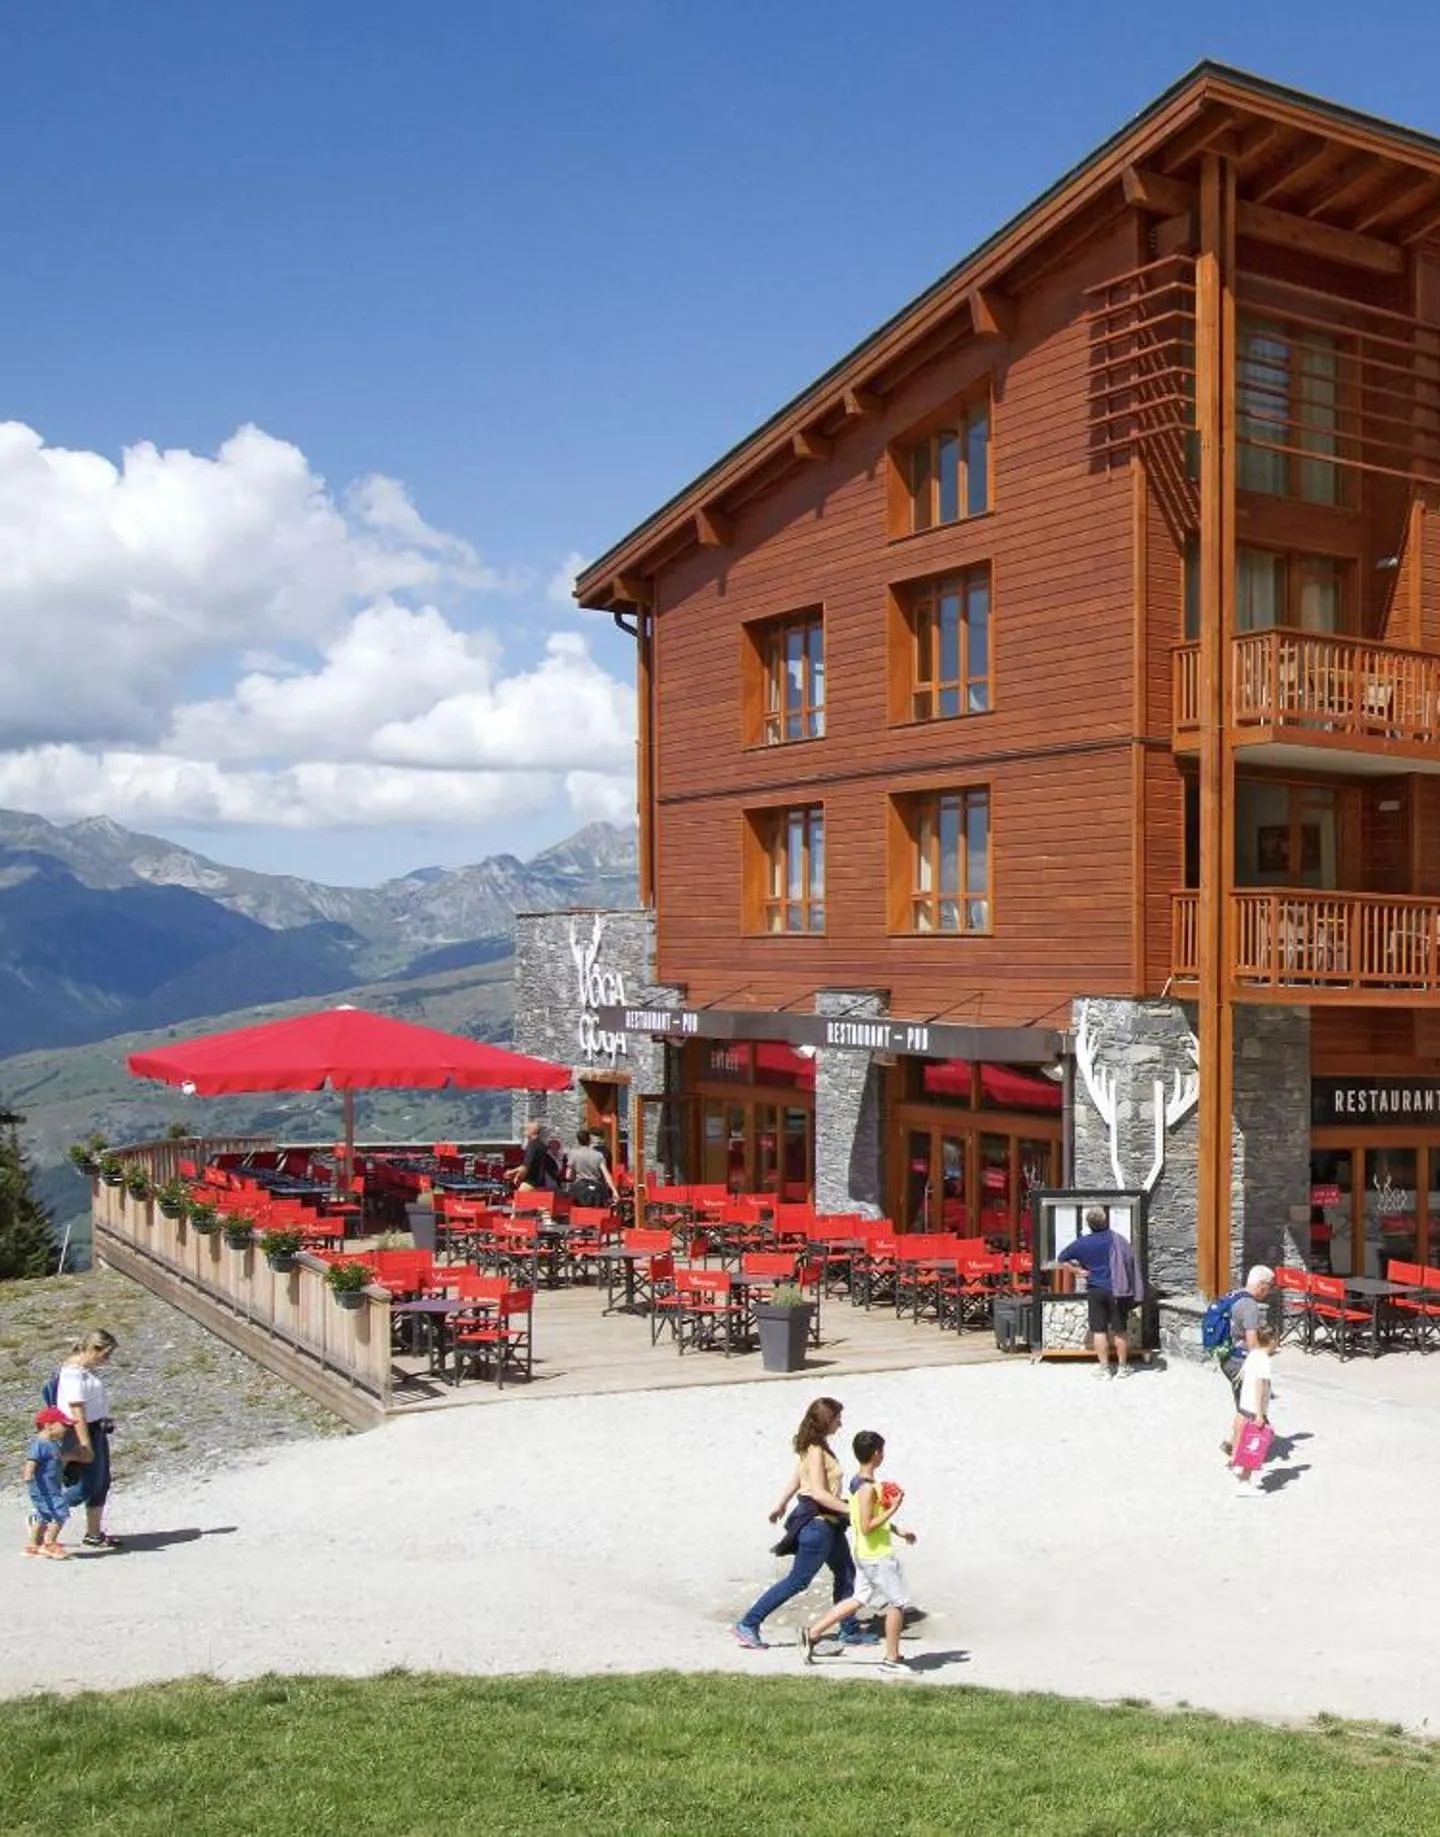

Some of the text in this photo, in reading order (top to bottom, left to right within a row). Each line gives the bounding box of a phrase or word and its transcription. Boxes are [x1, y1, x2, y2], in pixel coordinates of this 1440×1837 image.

[625, 1010, 671, 1031] RESTAURANT
[827, 1022, 891, 1047] RESTAURANT
[907, 1027, 929, 1050] PUB
